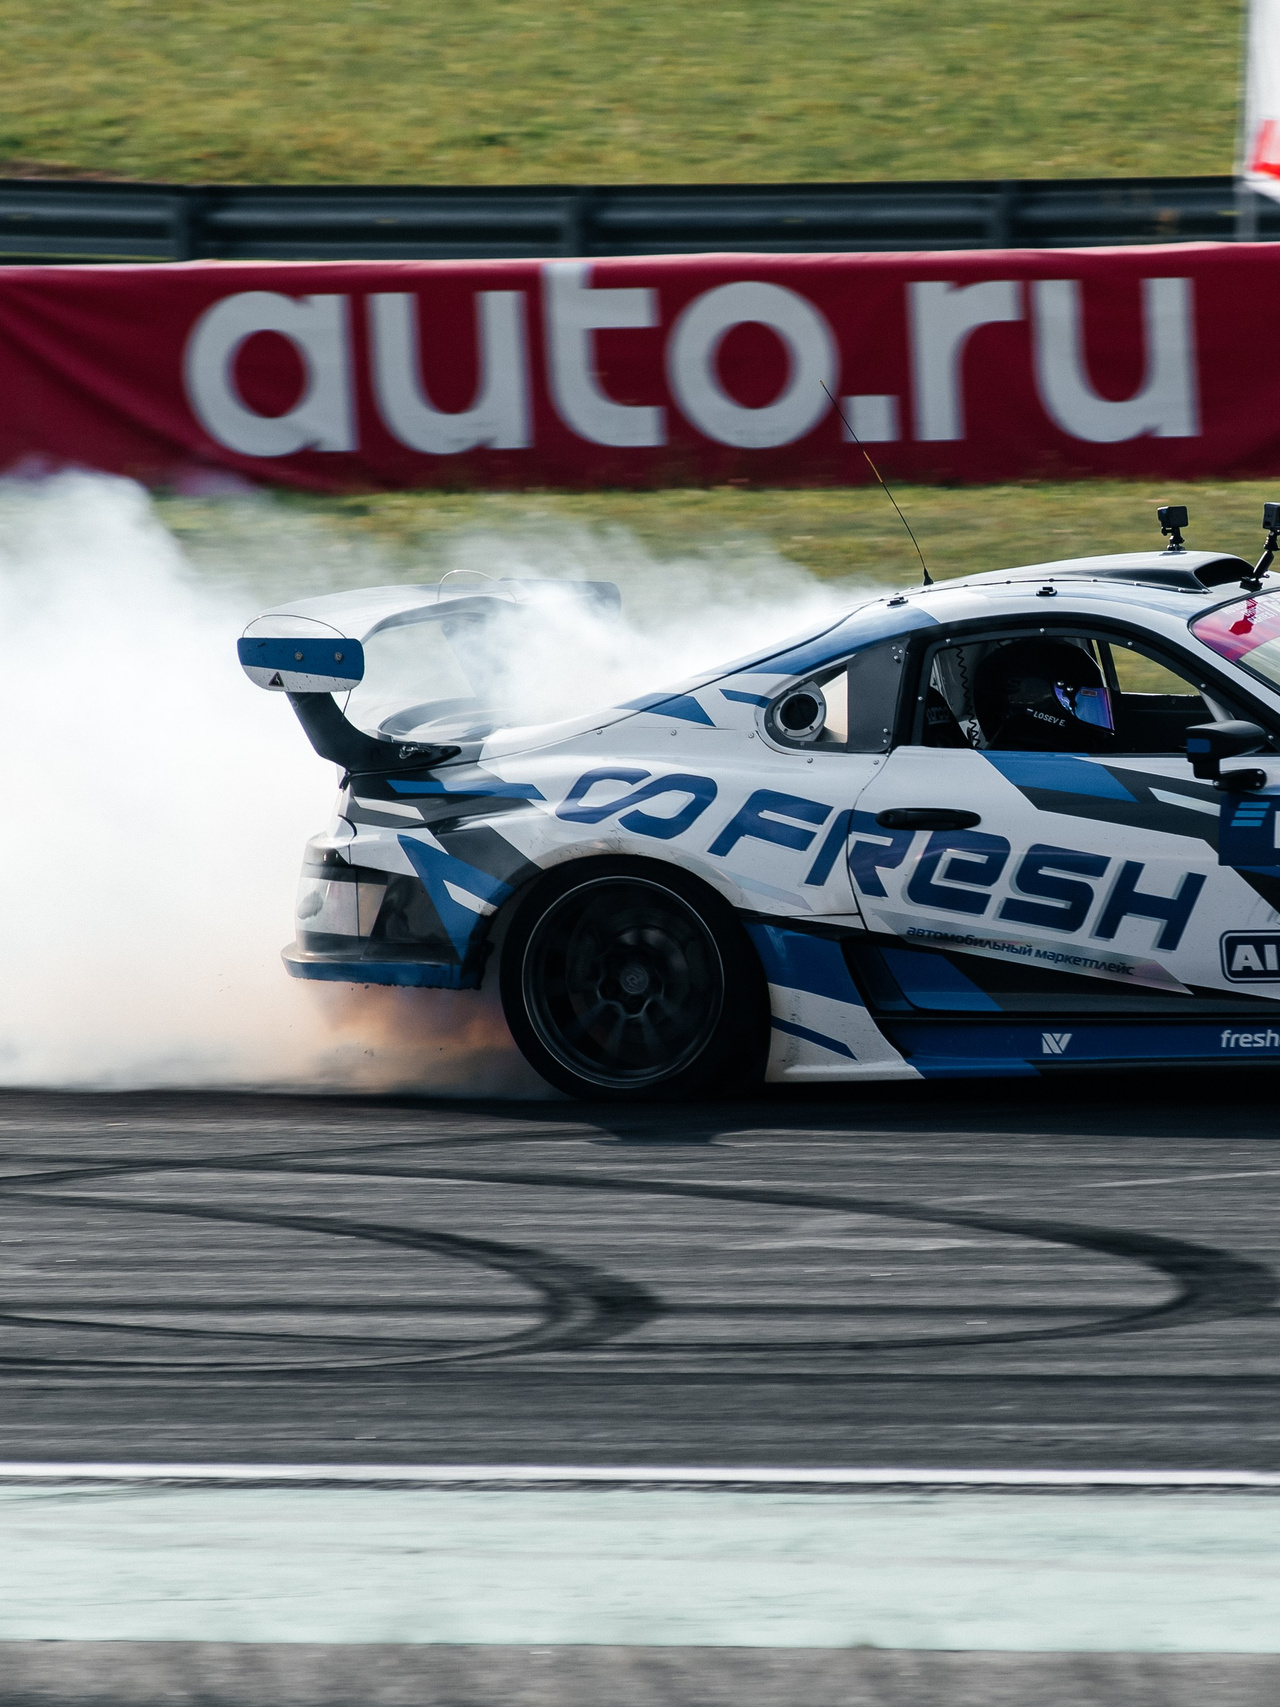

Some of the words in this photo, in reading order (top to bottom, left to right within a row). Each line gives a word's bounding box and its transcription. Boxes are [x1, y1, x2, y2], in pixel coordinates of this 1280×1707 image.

[182, 262, 1202, 457] auto.ru
[1033, 711, 1059, 724] LOSEV
[906, 925, 1033, 958] автомобильный
[1034, 947, 1136, 977] маркетплейс
